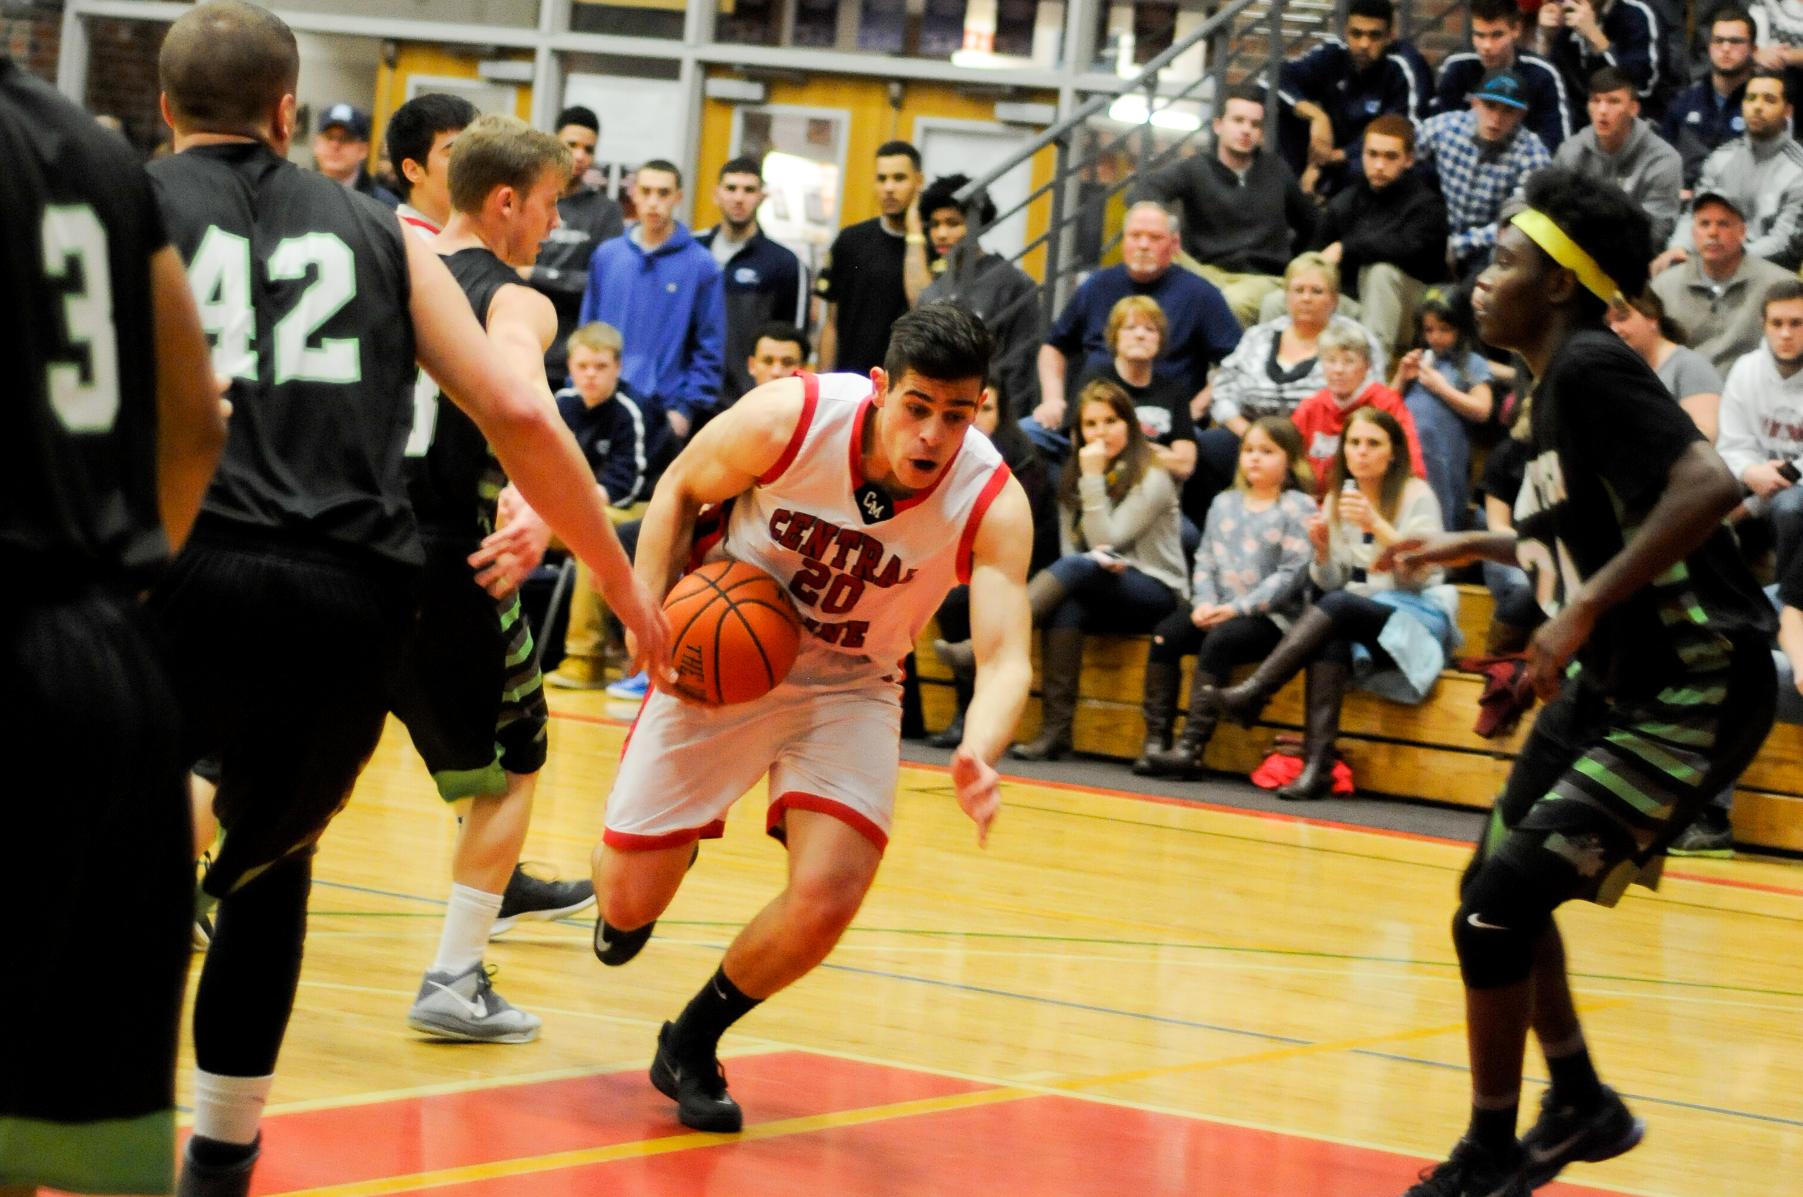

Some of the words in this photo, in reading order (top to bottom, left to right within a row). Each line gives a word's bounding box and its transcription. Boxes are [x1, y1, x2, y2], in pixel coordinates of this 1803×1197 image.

[42, 204, 120, 433] 3
[188, 224, 362, 384] 42
[862, 491, 885, 519] CM
[789, 557, 865, 614] 20
